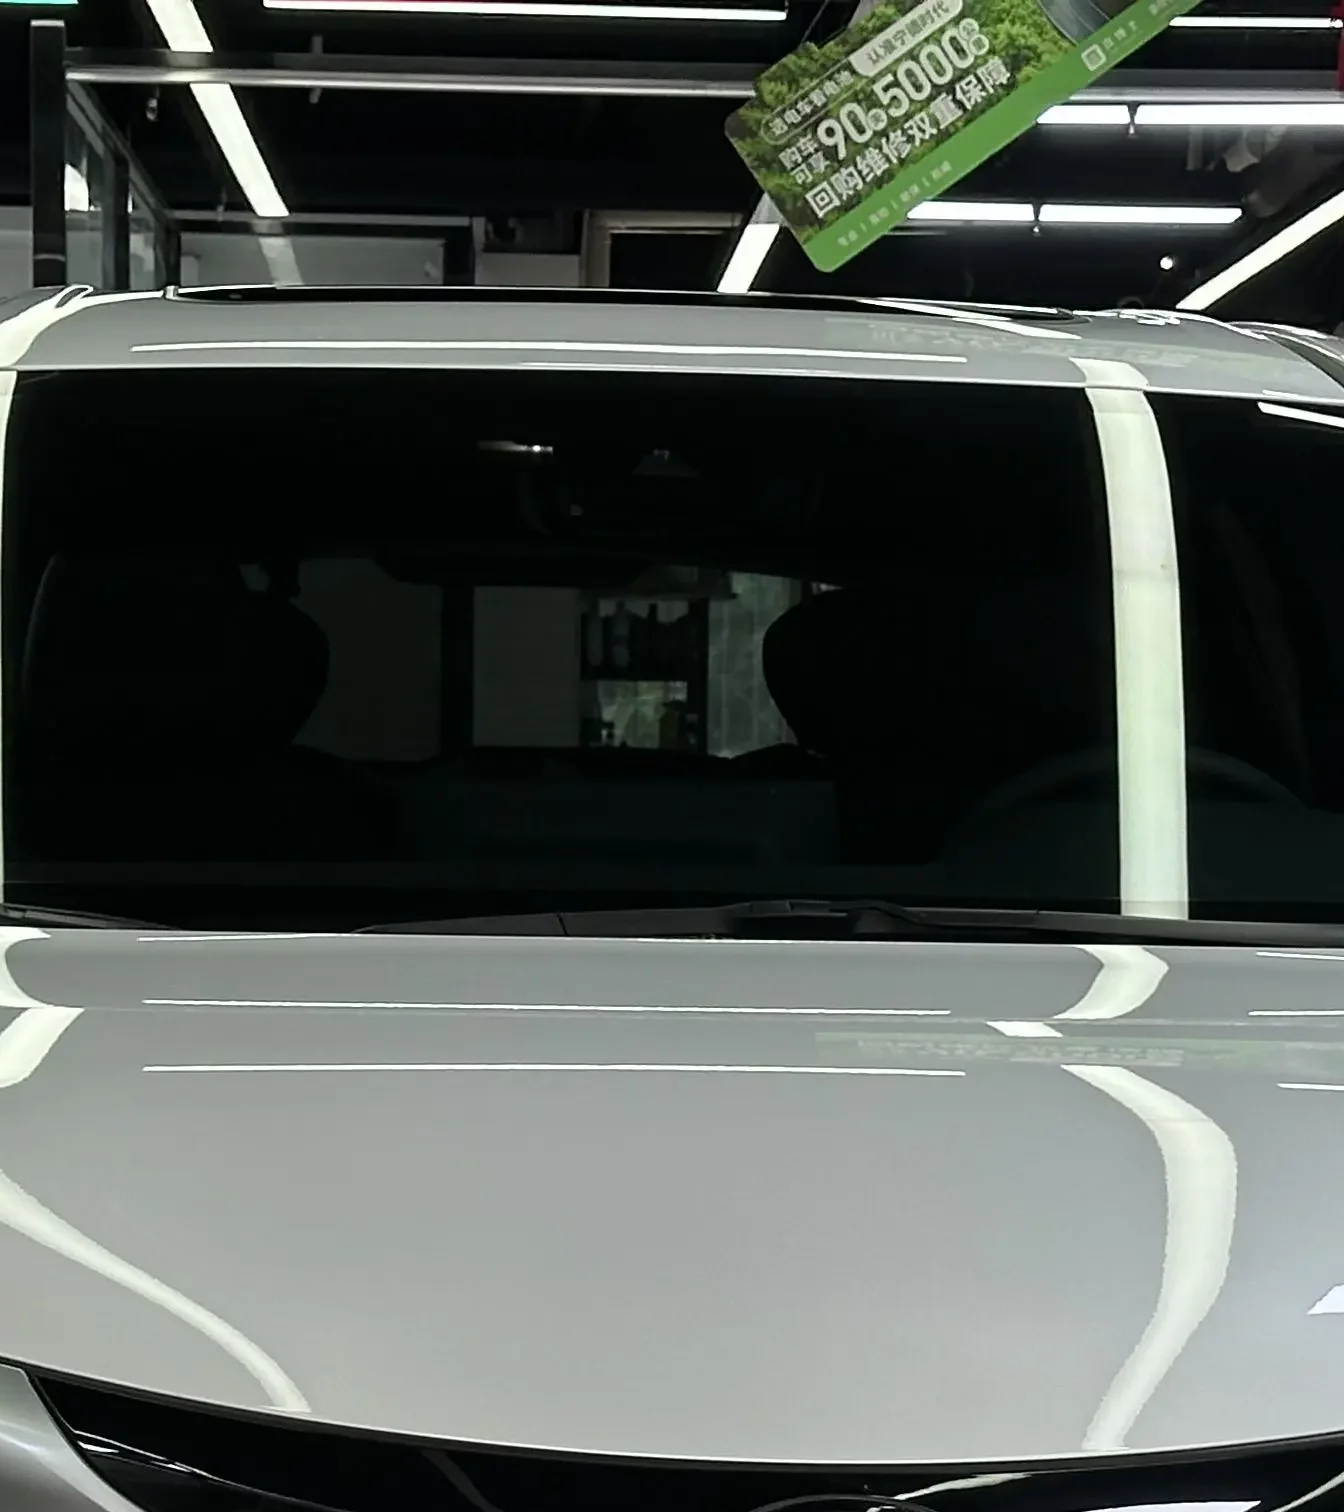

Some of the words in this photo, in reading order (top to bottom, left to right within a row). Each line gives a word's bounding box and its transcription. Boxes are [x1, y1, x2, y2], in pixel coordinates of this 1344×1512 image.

[805, 56, 1011, 218] 回购维修双重保障
